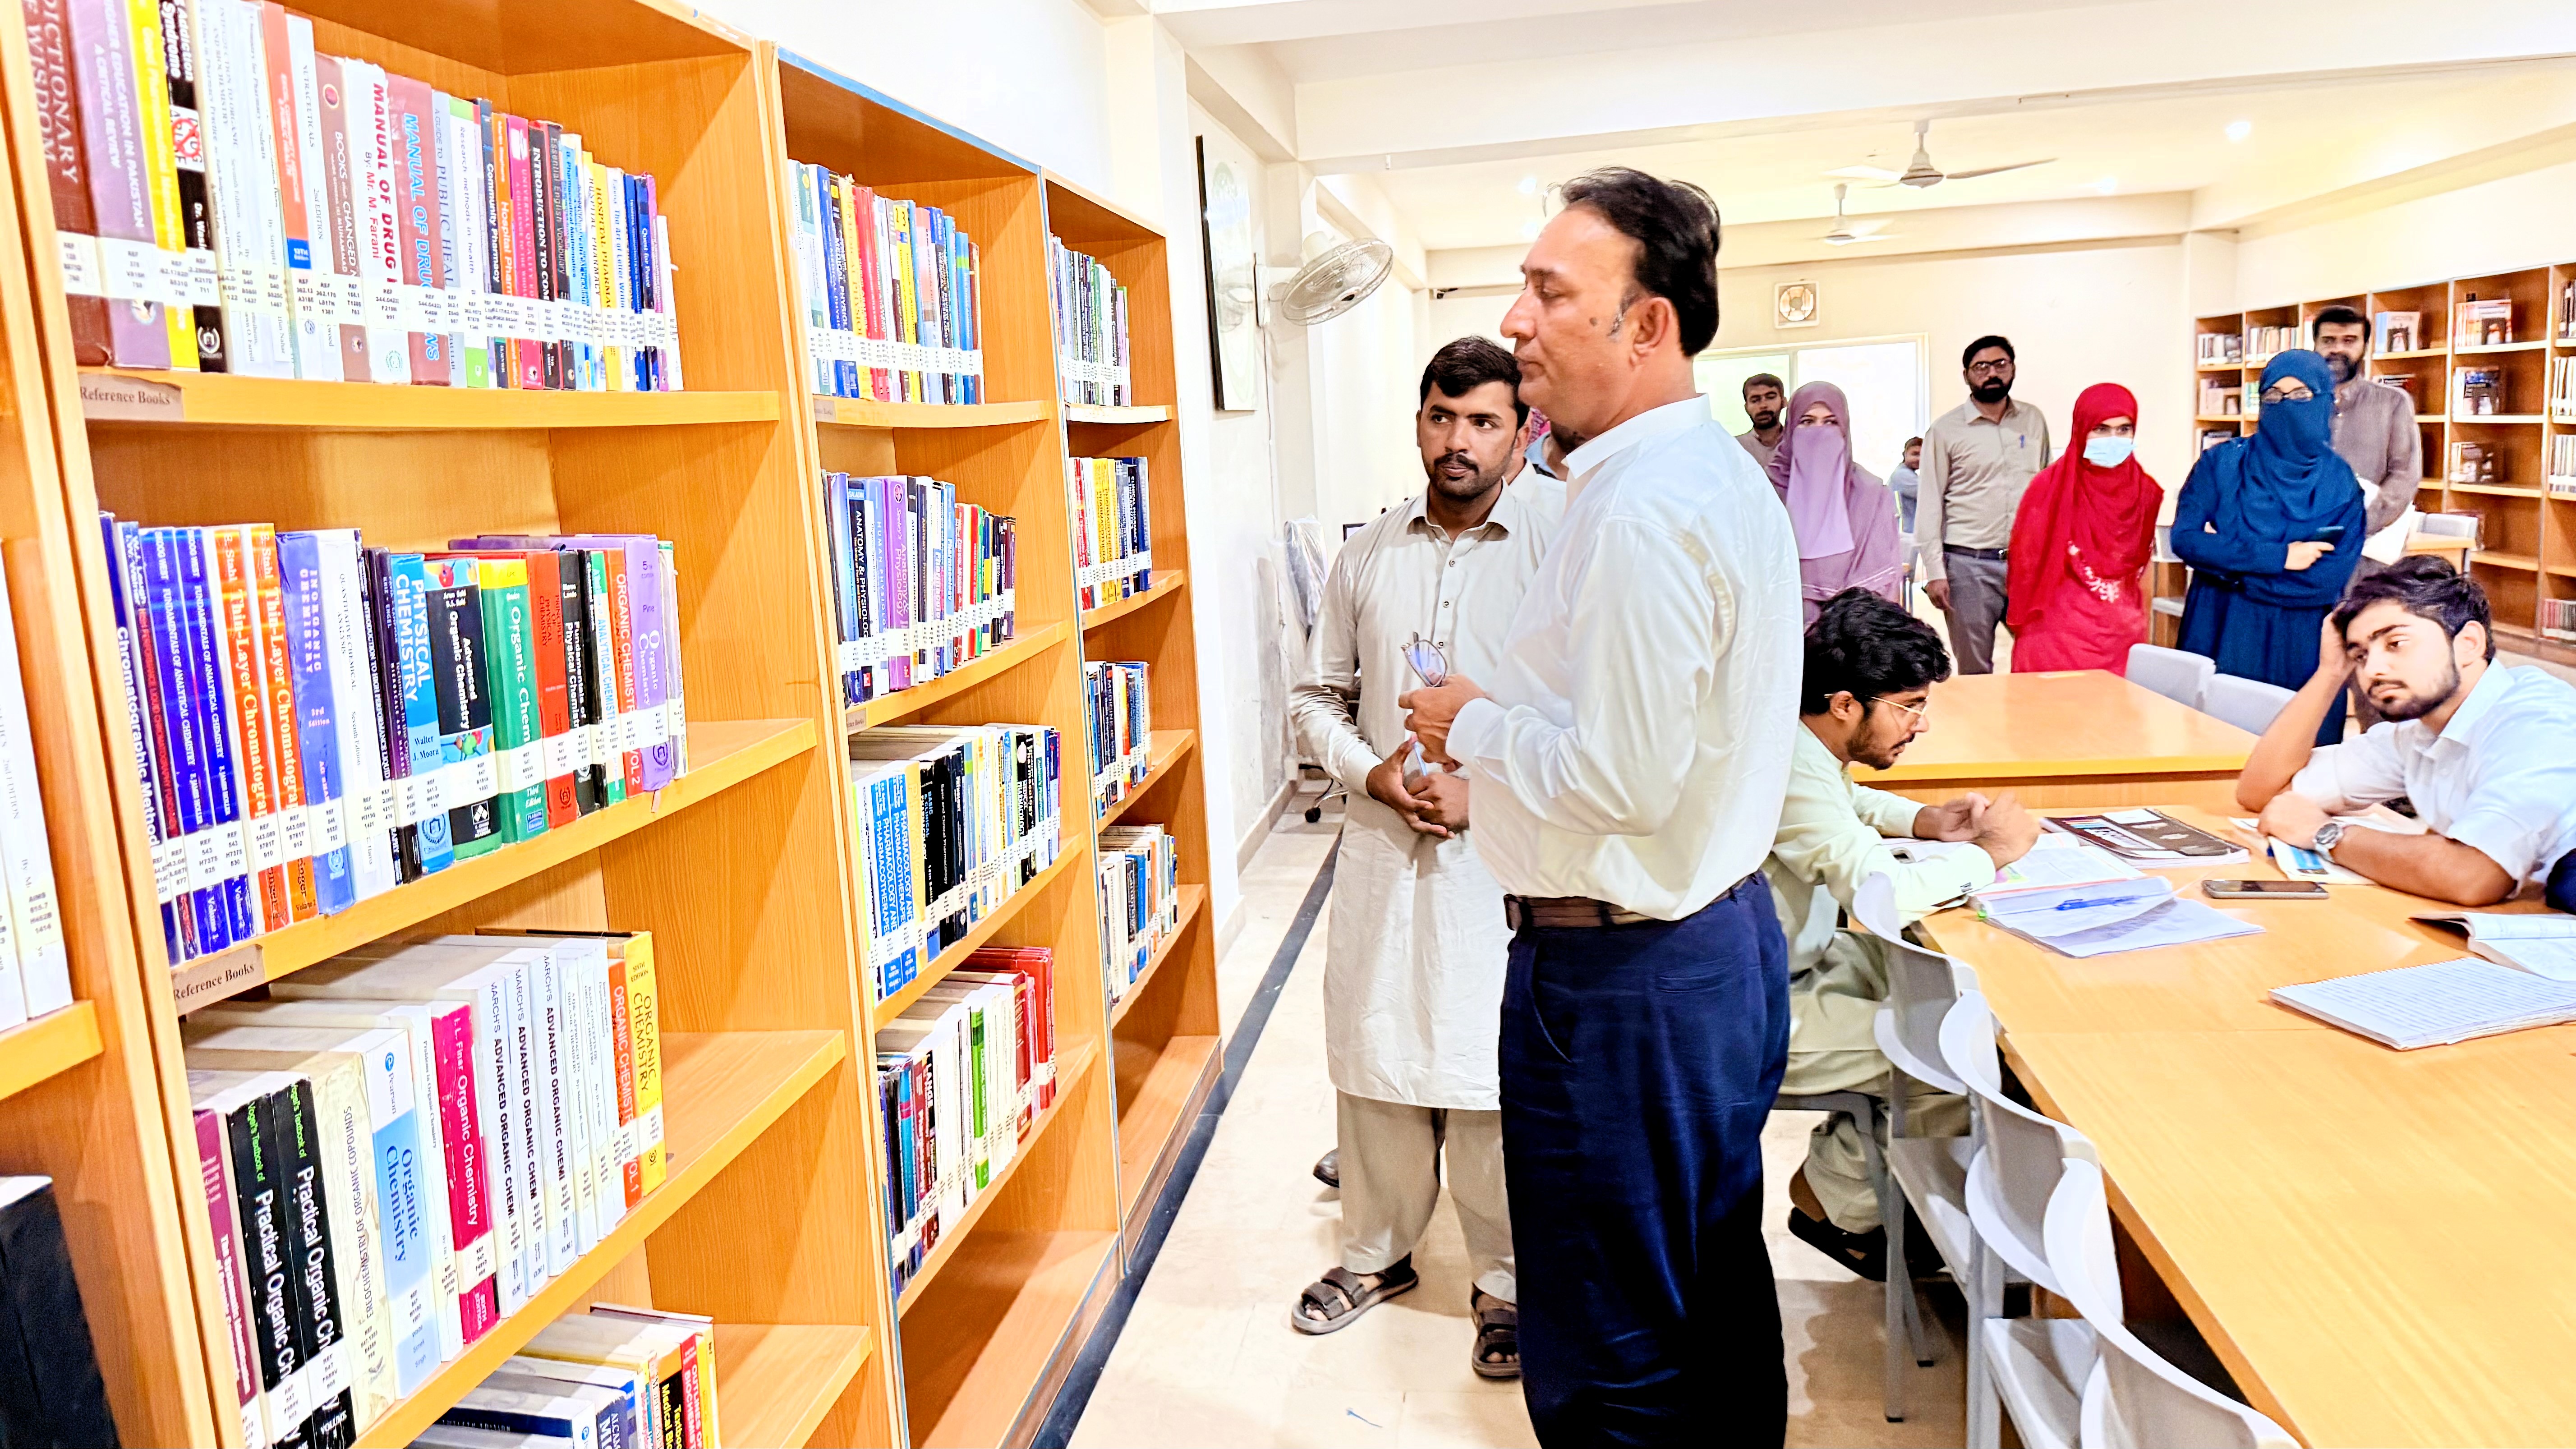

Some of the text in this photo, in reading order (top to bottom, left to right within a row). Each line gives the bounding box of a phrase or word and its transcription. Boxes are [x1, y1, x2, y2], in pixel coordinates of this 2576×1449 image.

[161, 1, 182, 78] Syndrome
[177, 6, 193, 82] Addiction
[27, 25, 56, 162] WISDOM
[94, 43, 122, 169] A CRITICAL REVIEW
[373, 83, 389, 170] MANUAL
[110, 51, 145, 228] EDUCATION IN PAKISTAN
[404, 112, 429, 236] MANUAL OF
[437, 147, 443, 159] TO
[194, 202, 203, 218] Dr.
[316, 203, 324, 240] EDITION
[335, 131, 356, 267] BOOKS CHANGED
[363, 152, 382, 259] By: Mr. M. Farani
[379, 179, 391, 205] OF
[436, 166, 451, 231] PUBLIC
[486, 163, 501, 283] Community Pharmacy
[501, 201, 512, 253] Hospital
[521, 169, 534, 278] UNIVERSAL QUALITY
[533, 147, 547, 269] INTRODUCTION TO
[551, 138, 565, 275] Essential English Vocabulary
[595, 187, 606, 248] HOSPITAL
[382, 212, 396, 270] DRUG
[467, 227, 472, 236] in
[80, 386, 170, 406] Reference Books
[856, 510, 865, 564] ANATOMY
[859, 565, 865, 576] &
[224, 534, 252, 690] E. Stahl Thin-Layer
[260, 531, 286, 686] E. Stahl Thin-Layer
[544, 598, 552, 641] PHYSICAL
[616, 573, 631, 639] ORGANIC
[894, 548, 903, 616] Physiology
[154, 530, 196, 766] SKOOG WEST FUNDAMENTALS ANALYTICAL CHEMISTRY
[187, 529, 224, 759] SKOOG WEST FUNDAMENTALS OF ANALYTICAL CHEMISTRY
[299, 568, 313, 674] CHEMISTRY
[309, 570, 322, 672] INORGANIC
[338, 611, 346, 654] ANALYSIS
[339, 573, 358, 691] QUANTITATIVE CHEMICAL
[395, 573, 419, 702] CHEMISTRY
[411, 579, 431, 688] PHYSICAL
[510, 606, 527, 683] Organic
[539, 595, 548, 648] CHEMISTRY
[564, 621, 576, 673] Physical
[598, 619, 611, 675] ANALYTICAL
[363, 600, 391, 780] INTRODUCTION TO LIQUID
[449, 611, 470, 730] Organic Chemistry
[463, 638, 478, 701] Advanced
[573, 621, 587, 718] Fundamentals of
[639, 633, 651, 706] Chemistry
[649, 630, 660, 690] Organic
[117, 626, 148, 779] Chromatographic
[140, 781, 162, 847] Method
[308, 718, 330, 728] Edition
[311, 707, 325, 717] 3rd
[414, 735, 434, 746] Walter
[412, 752, 419, 761] J.
[632, 777, 640, 785] 2
[200, 838, 212, 846] REF
[202, 847, 213, 856] 543
[293, 841, 303, 849] 912
[882, 817, 898, 932] PHARMACOLOGY AND
[900, 809, 914, 920] PHARMACOLOGY AND
[207, 897, 217, 933] Volume
[174, 964, 254, 1001] Reference Books
[631, 970, 649, 982] EDITION
[543, 954, 563, 1138] MARCH'S ADVANCED ORGANIC
[613, 985, 629, 1052] ORGANIC
[633, 993, 649, 1091] CHEMISTRY
[644, 995, 657, 1082] ORGANIC
[388, 1072, 396, 1115] Pearson
[490, 981, 512, 1174] MARCH'S ADVANCED ORGANIC
[515, 968, 534, 1159] MARCH'S ADVANCED ORGANIC
[247, 1100, 264, 1173] Vogel's Textbook
[294, 1109, 306, 1149] Textbook
[455, 1041, 478, 1227] Finar Organic Chemistry
[343, 1105, 365, 1232] OF ORGANIC COPOUNDS
[386, 1145, 406, 1261] Chemistry
[401, 1148, 419, 1240] Organic
[255, 1188, 292, 1350] Practical Organic
[297, 1165, 331, 1323] Practical Organic
[661, 1383, 672, 1432] Medical
[691, 1364, 702, 1430] OUTLINES
